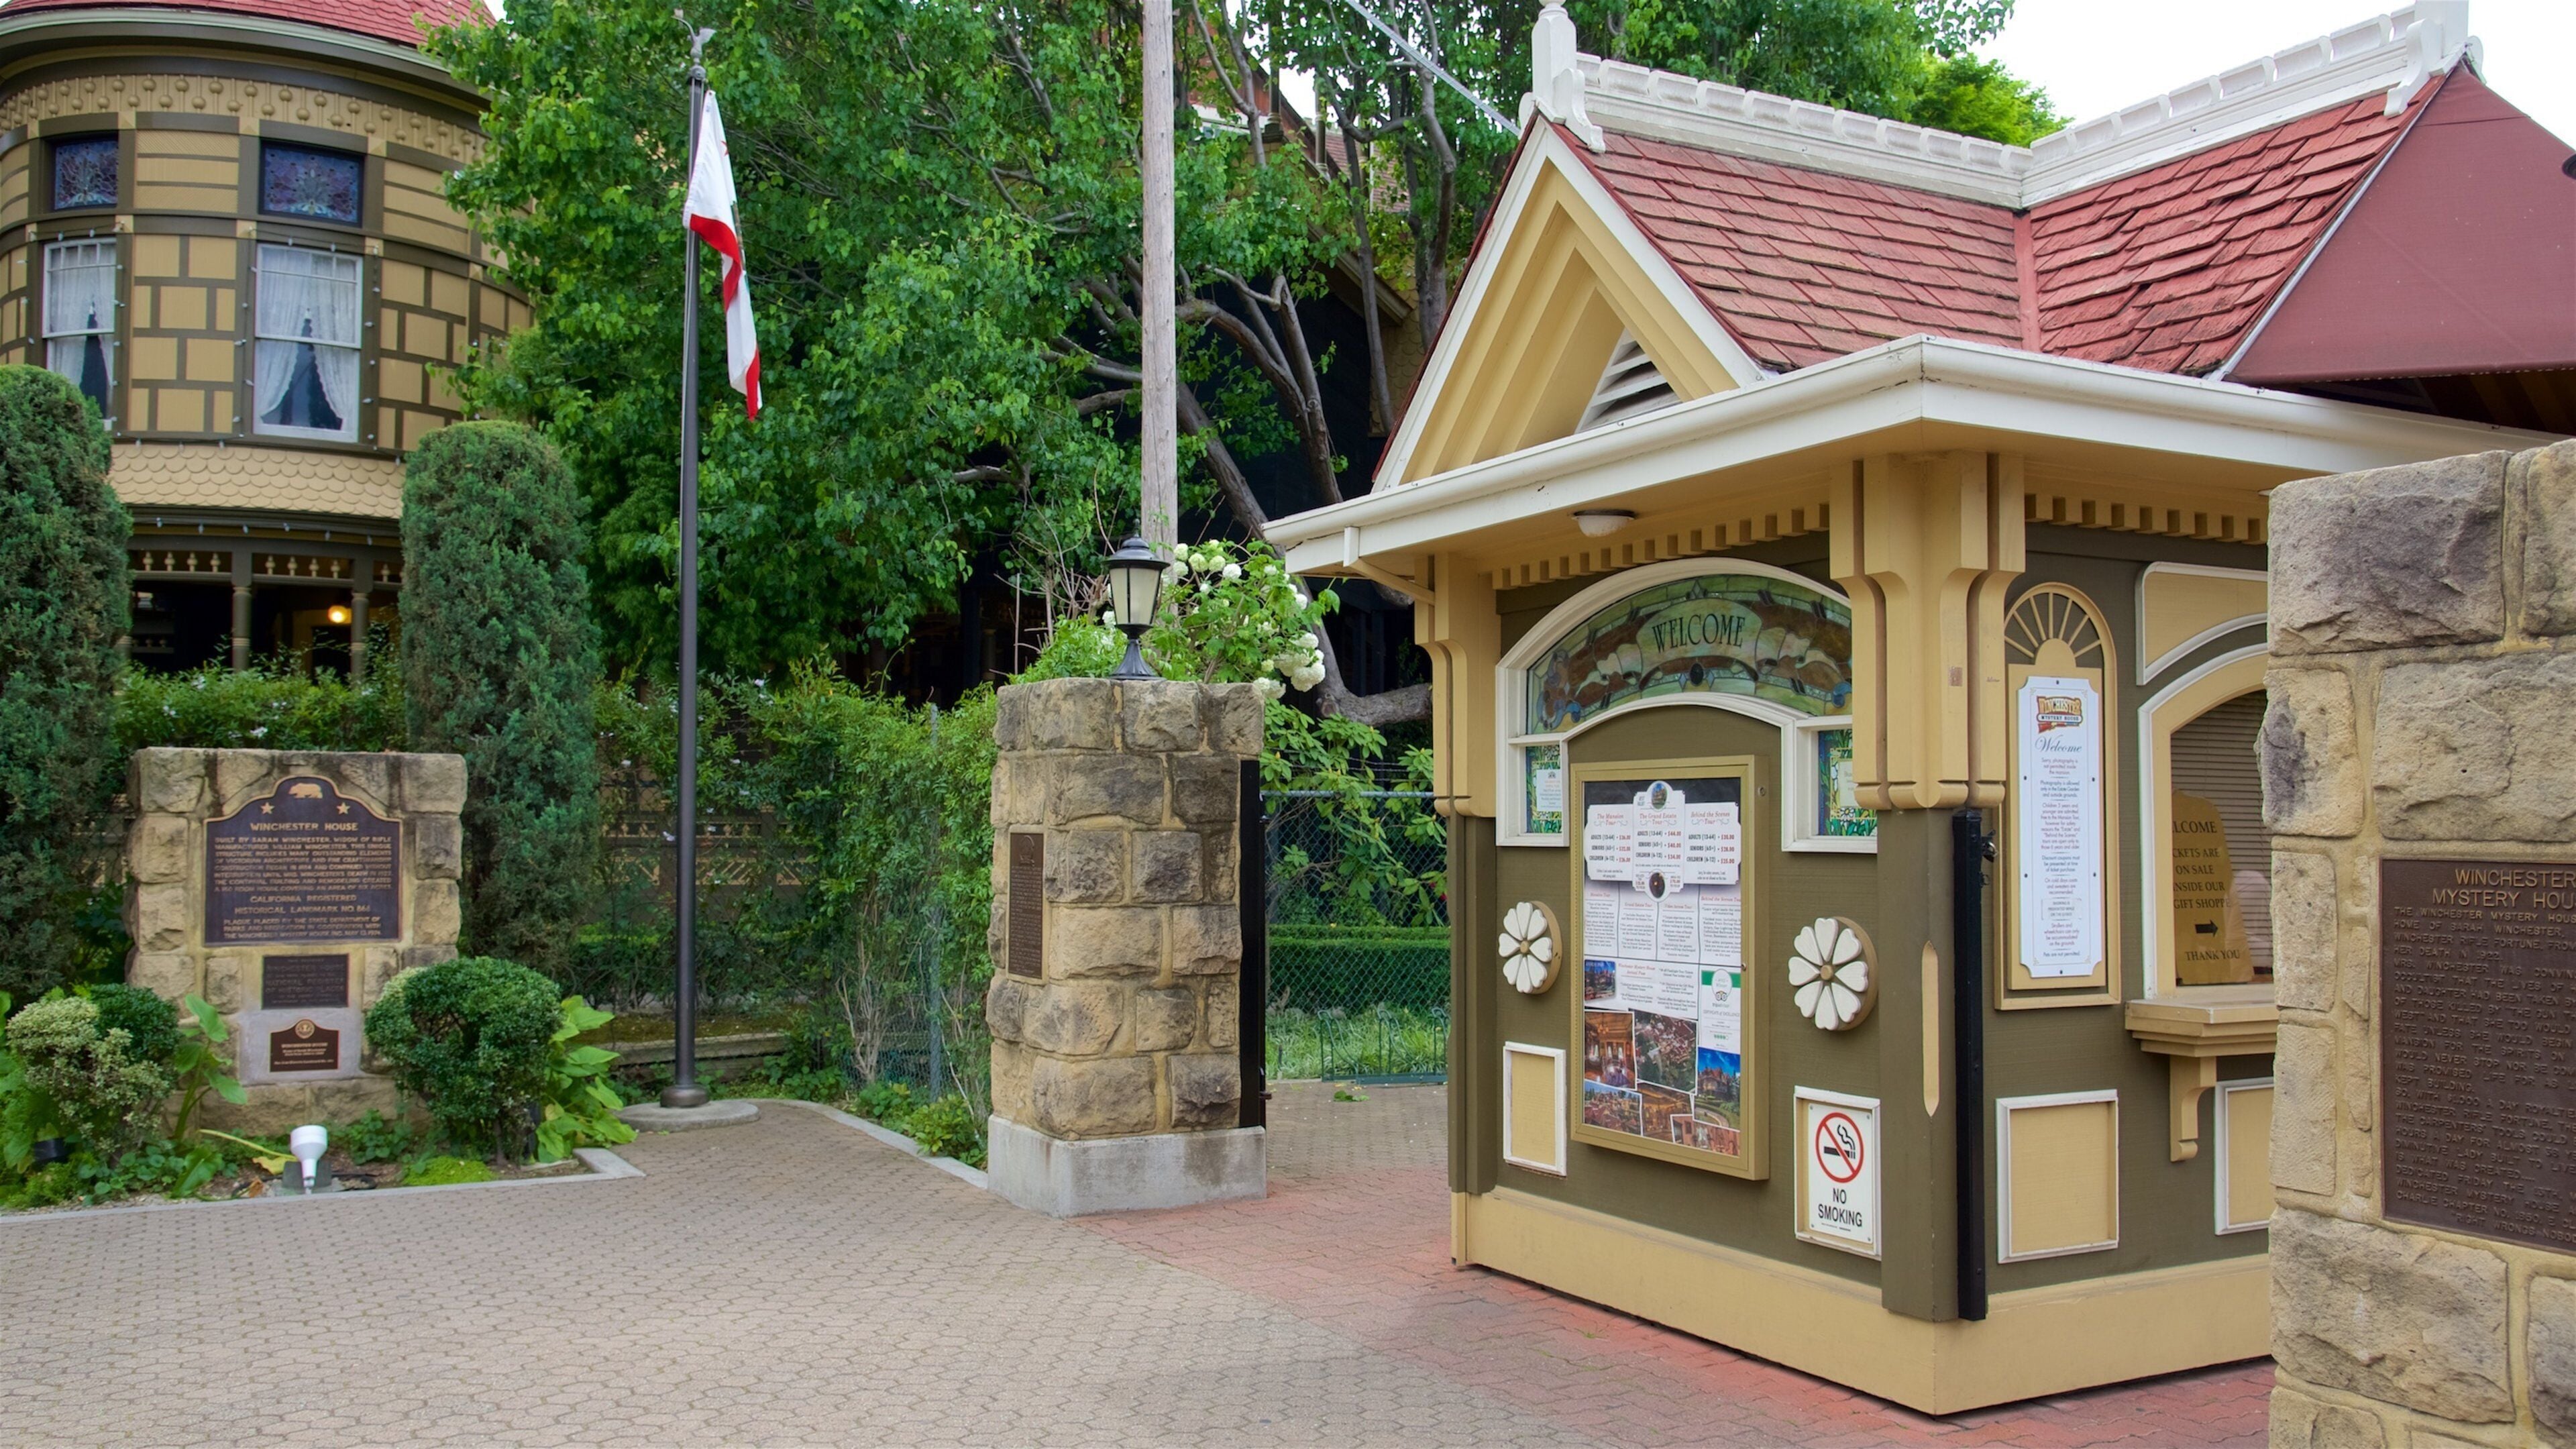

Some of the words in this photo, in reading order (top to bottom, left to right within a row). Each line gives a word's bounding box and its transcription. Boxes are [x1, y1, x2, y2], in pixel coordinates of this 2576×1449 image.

[1652, 614, 1745, 653] WELCOME
[2039, 697, 2080, 714] WINCHESTER
[2035, 735, 2082, 752] Welcome
[250, 822, 319, 831] WINCHESTER
[324, 822, 359, 831] HOUSE
[2172, 820, 2217, 834] LCOME
[2203, 848, 2220, 858] ARE
[2176, 865, 2190, 875] ON
[2192, 865, 2214, 875] SALE
[2455, 868, 2576, 888] WINCHESTER
[2205, 881, 2225, 892] OUR
[2174, 899, 2193, 910] GIFT
[2196, 898, 2230, 909] SHOPPE
[2432, 887, 2520, 907] MYSTERY
[2533, 892, 2576, 910] HOU
[235, 906, 286, 914] HISTORICAL
[2394, 906, 2413, 915] THE
[2420, 908, 2482, 919] WINCHESTER
[2490, 912, 2538, 922] MYSTERY
[2394, 919, 2420, 929] HOME
[2430, 921, 2442, 930] OF
[2451, 922, 2483, 932] SARAH
[2394, 932, 2453, 944] WINCHESTER
[2461, 936, 2489, 946] RIFLE
[2185, 951, 2220, 961] THANK
[2220, 949, 2241, 959] YOU
[2394, 945, 2412, 954] HER
[2420, 947, 2450, 957] DEATH
[2459, 949, 2467, 958] IN
[2427, 960, 2489, 973] WINCHESTER
[2501, 966, 2522, 976] WAS
[2452, 975, 2477, 985] THAT
[2484, 978, 2504, 987] THE
[2550, 983, 2564, 992] OF
[2417, 986, 2466, 998] DAUGHTER
[2495, 992, 2521, 1003] BEEN
[2527, 995, 2558, 1006] TAKEN
[2411, 998, 2443, 1009] THOSE
[2448, 1001, 2482, 1012] KILLED
[2535, 1023, 2571, 1034] WOULD
[2395, 1036, 2435, 1048] MANSION
[2501, 1047, 2541, 1059] SPIRITS
[2470, 1031, 2489, 1040] SHE
[2542, 1038, 2571, 1049] BEGIN
[2435, 1053, 2467, 1065] NEVER
[2474, 1057, 2500, 1068] STOP
[2423, 1065, 2472, 1078] PROMISED
[2396, 1165, 2448, 1181] DEDICATED
[2458, 1174, 2493, 1188] FRIDAY
[1833, 1188, 1846, 1204] NO
[2396, 1177, 2458, 1195] WINCHESTER
[2466, 1189, 2515, 1205] MYSTERY
[2396, 1191, 2438, 1205] CHARLIE
[2443, 1198, 2488, 1214] CHAPTER
[1818, 1203, 1862, 1227] SMOKING
